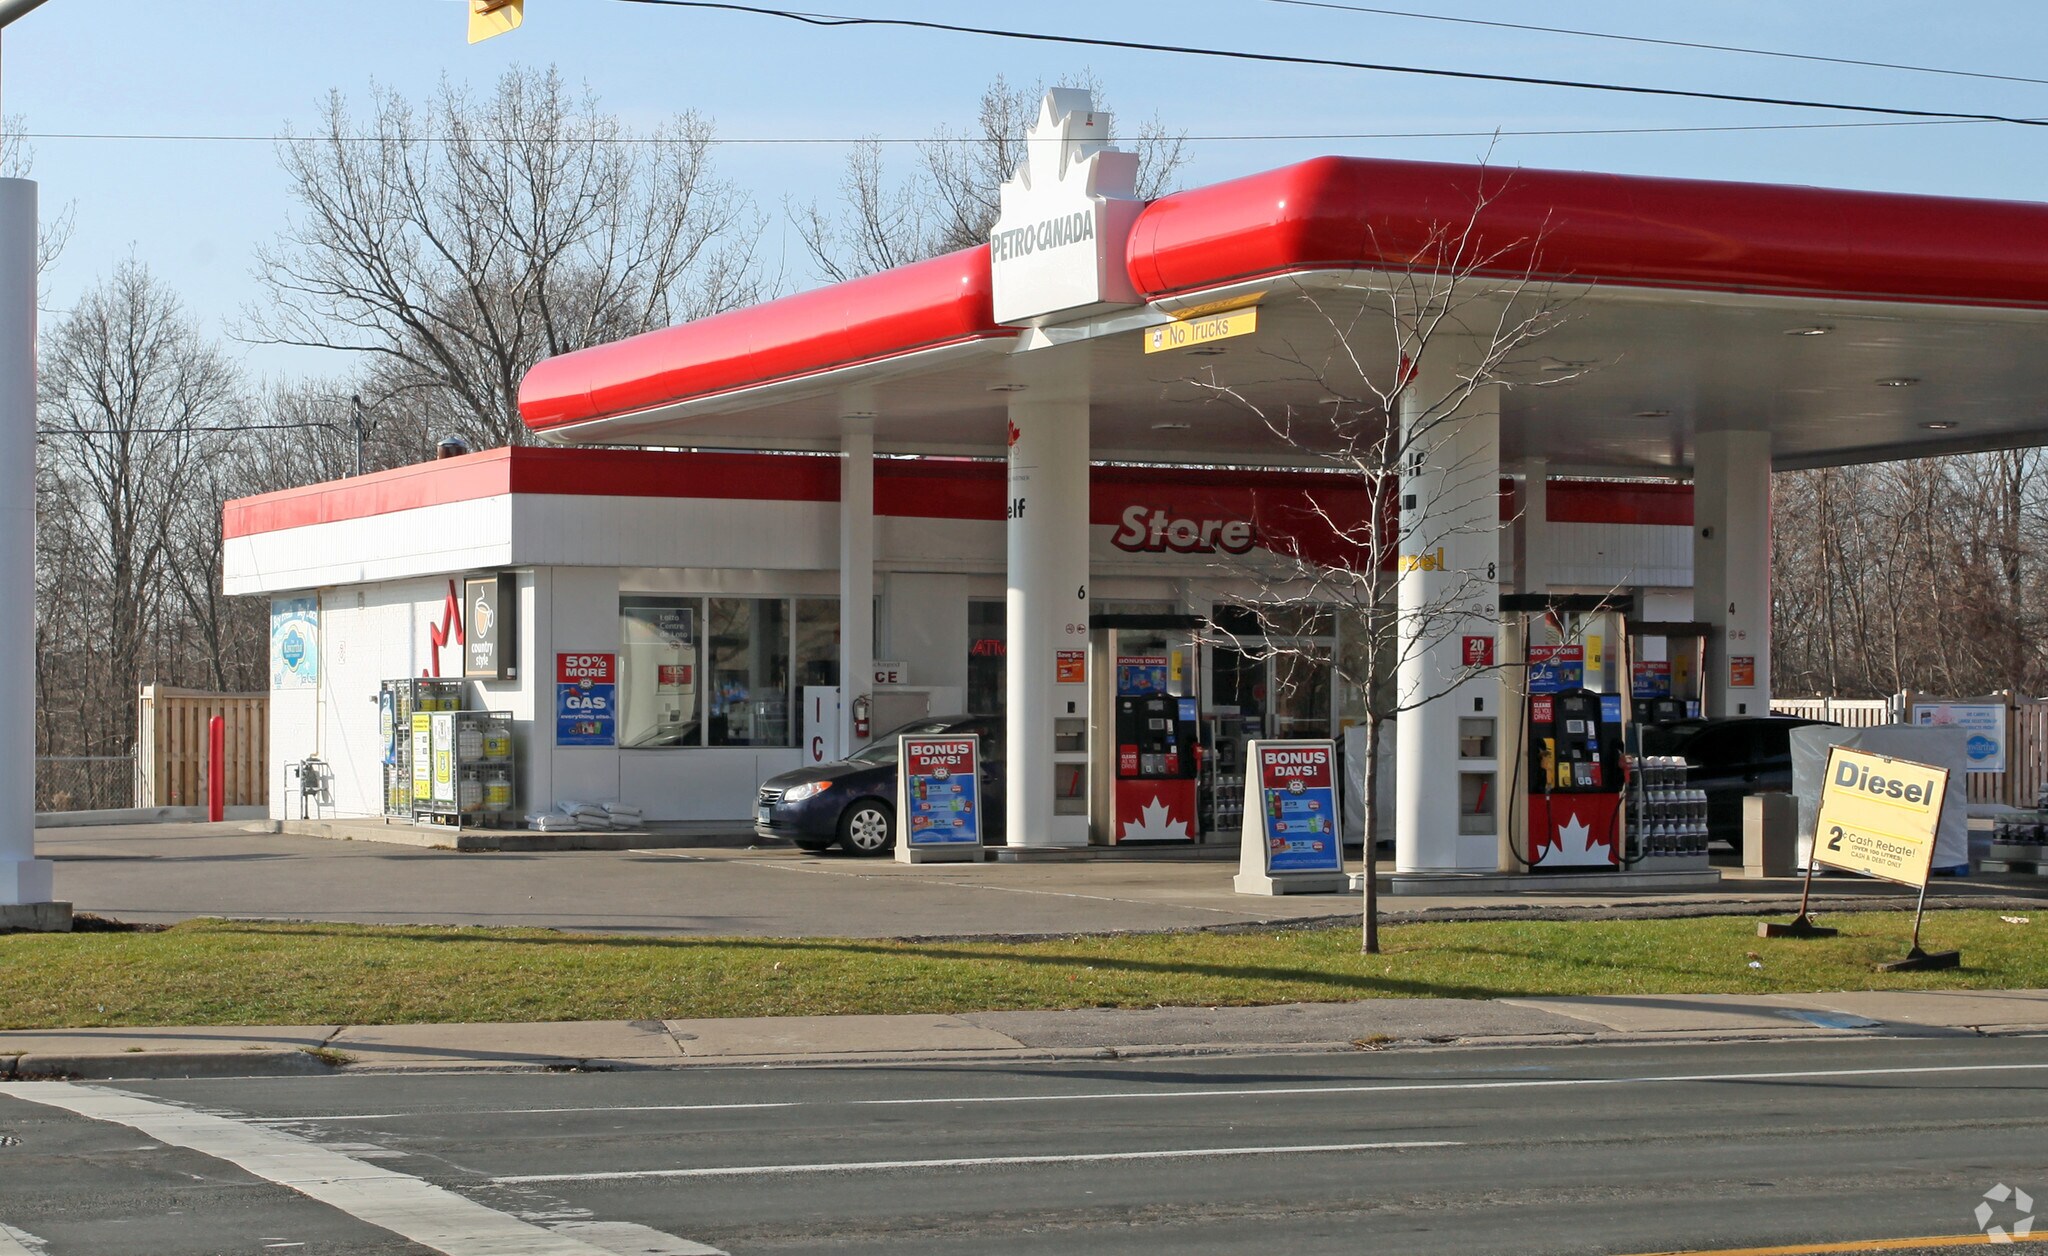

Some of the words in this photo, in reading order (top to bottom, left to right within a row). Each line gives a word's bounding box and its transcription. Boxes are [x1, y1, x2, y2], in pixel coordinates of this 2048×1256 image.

[1169, 326, 1186, 346] No
[1191, 317, 1229, 341] Trucks
[1117, 504, 1251, 549] Store
[1487, 561, 1496, 580] 8
[1077, 584, 1086, 600] 6
[1728, 602, 1736, 615] 4
[471, 641, 494, 657] country
[1470, 638, 1485, 652] 20
[475, 651, 489, 669] style
[565, 655, 607, 668] 50%
[565, 668, 607, 678] MORE
[1530, 671, 1554, 680] GAS
[566, 696, 607, 710] GAS
[910, 744, 970, 756] BONUS
[920, 756, 961, 766] DAYS!
[1264, 751, 1326, 765] BONUS
[1274, 765, 1318, 777] DAYS!
[1834, 760, 1934, 806] Diesel
[1848, 833, 1874, 848] Cash
[1876, 839, 1916, 858] Rebate!
[1850, 851, 1866, 860] CASH
[1871, 856, 1886, 865] DEBIT
[1886, 860, 1902, 869] ONLY
[1851, 845, 1869, 853] (OVER
[1881, 851, 1903, 862] LITRES)
